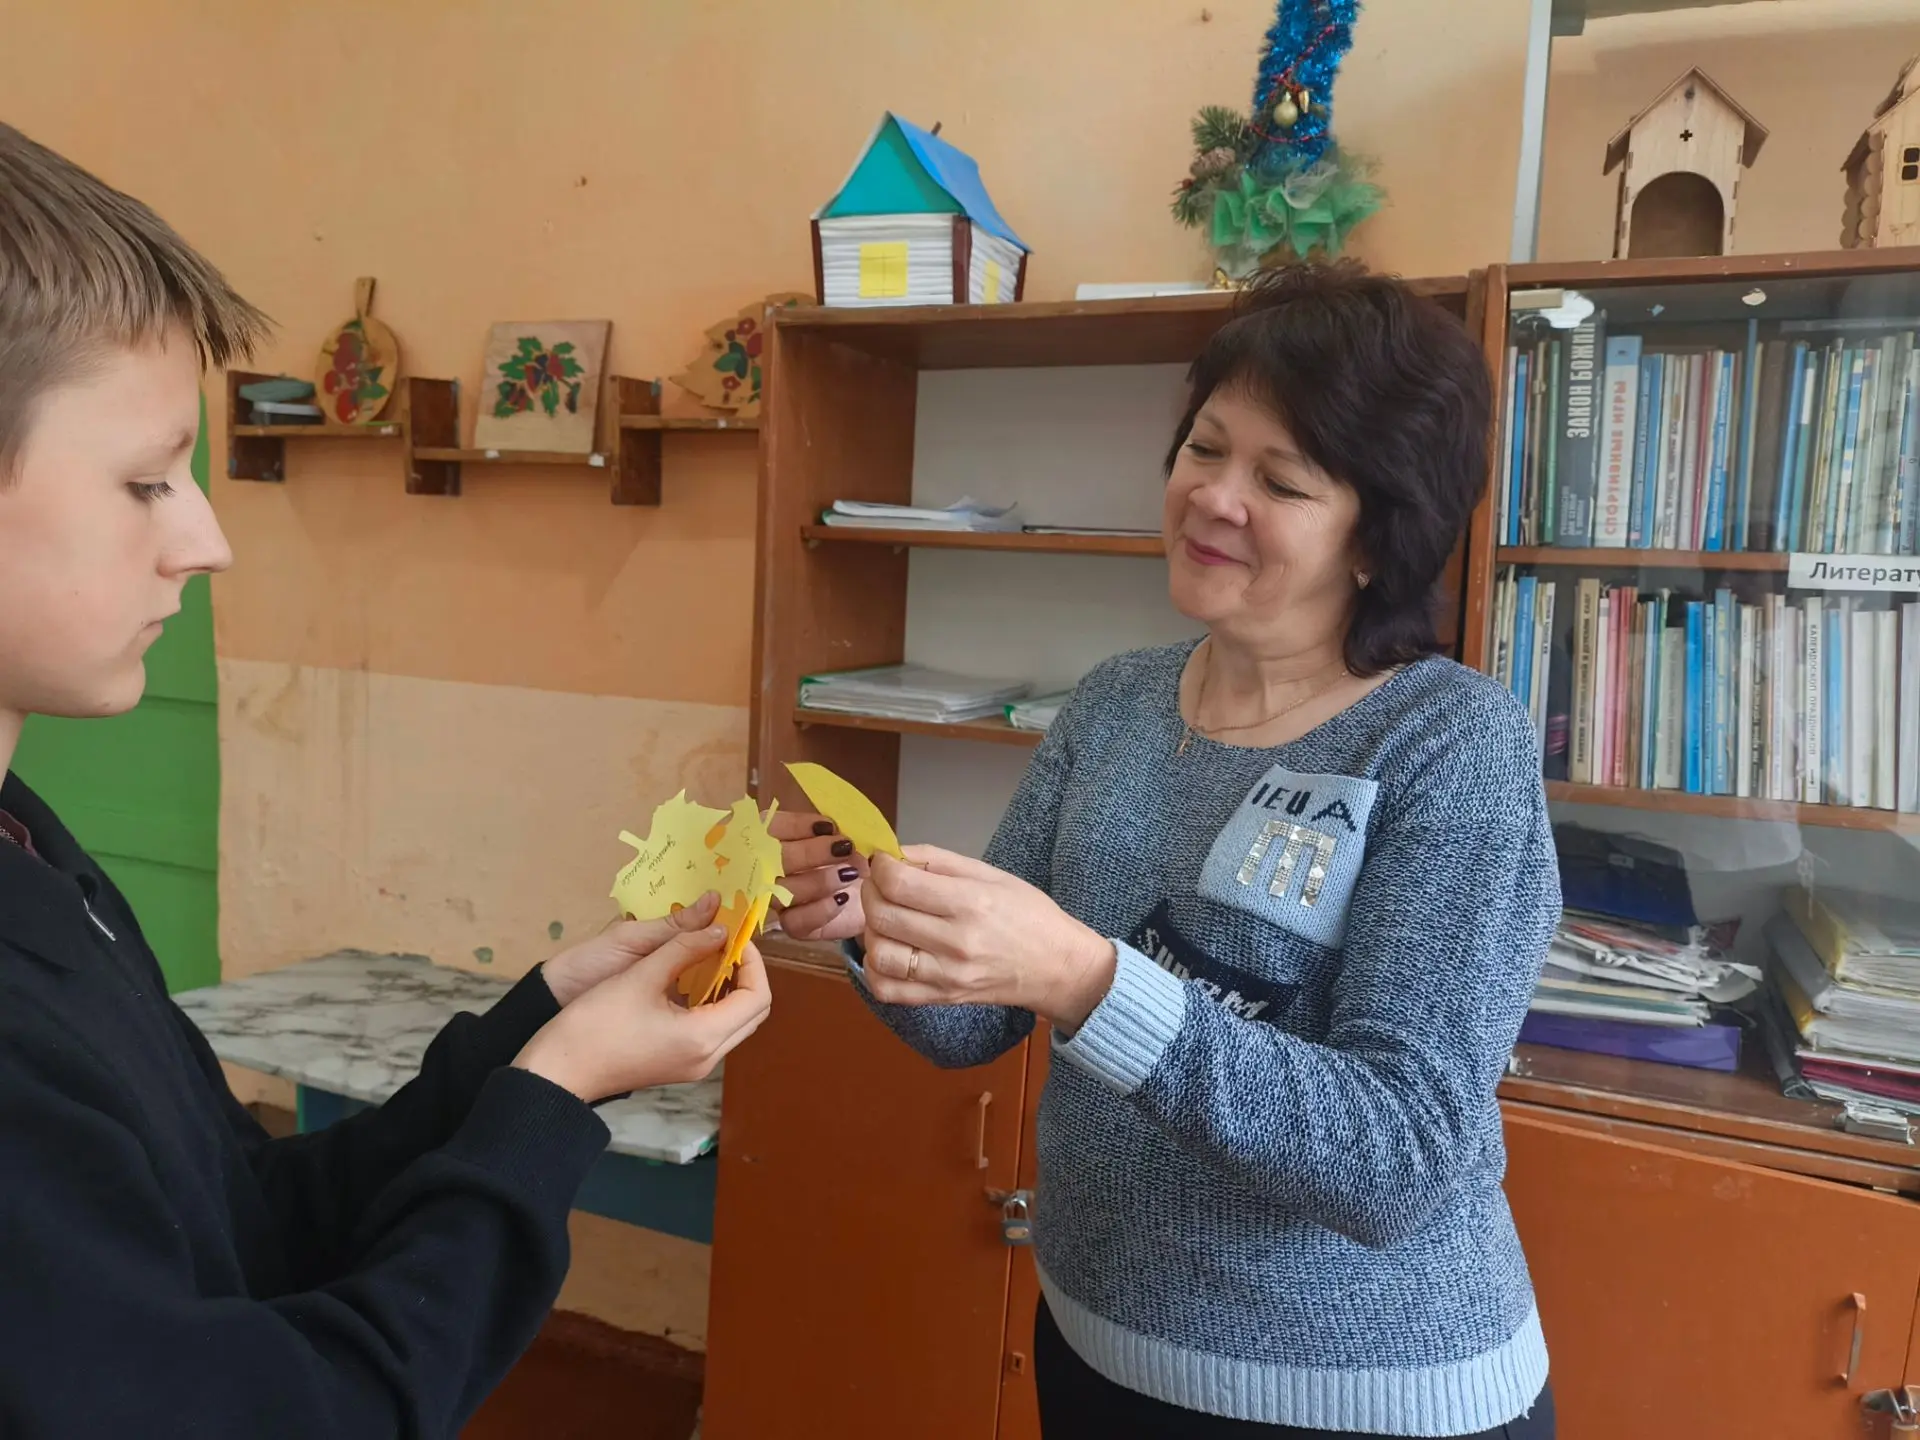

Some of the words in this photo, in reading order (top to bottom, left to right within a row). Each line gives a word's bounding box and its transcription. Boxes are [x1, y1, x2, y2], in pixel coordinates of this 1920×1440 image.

[1566, 386, 1592, 438] ЗАКОН
[1612, 381, 1626, 423] ИГРЫ
[1605, 430, 1624, 535] СПОРТИВНЫЕ
[1808, 624, 1818, 691] КАЛЕЙДОСКОП
[1808, 696, 1818, 756] ПРАЗДНИКОВ
